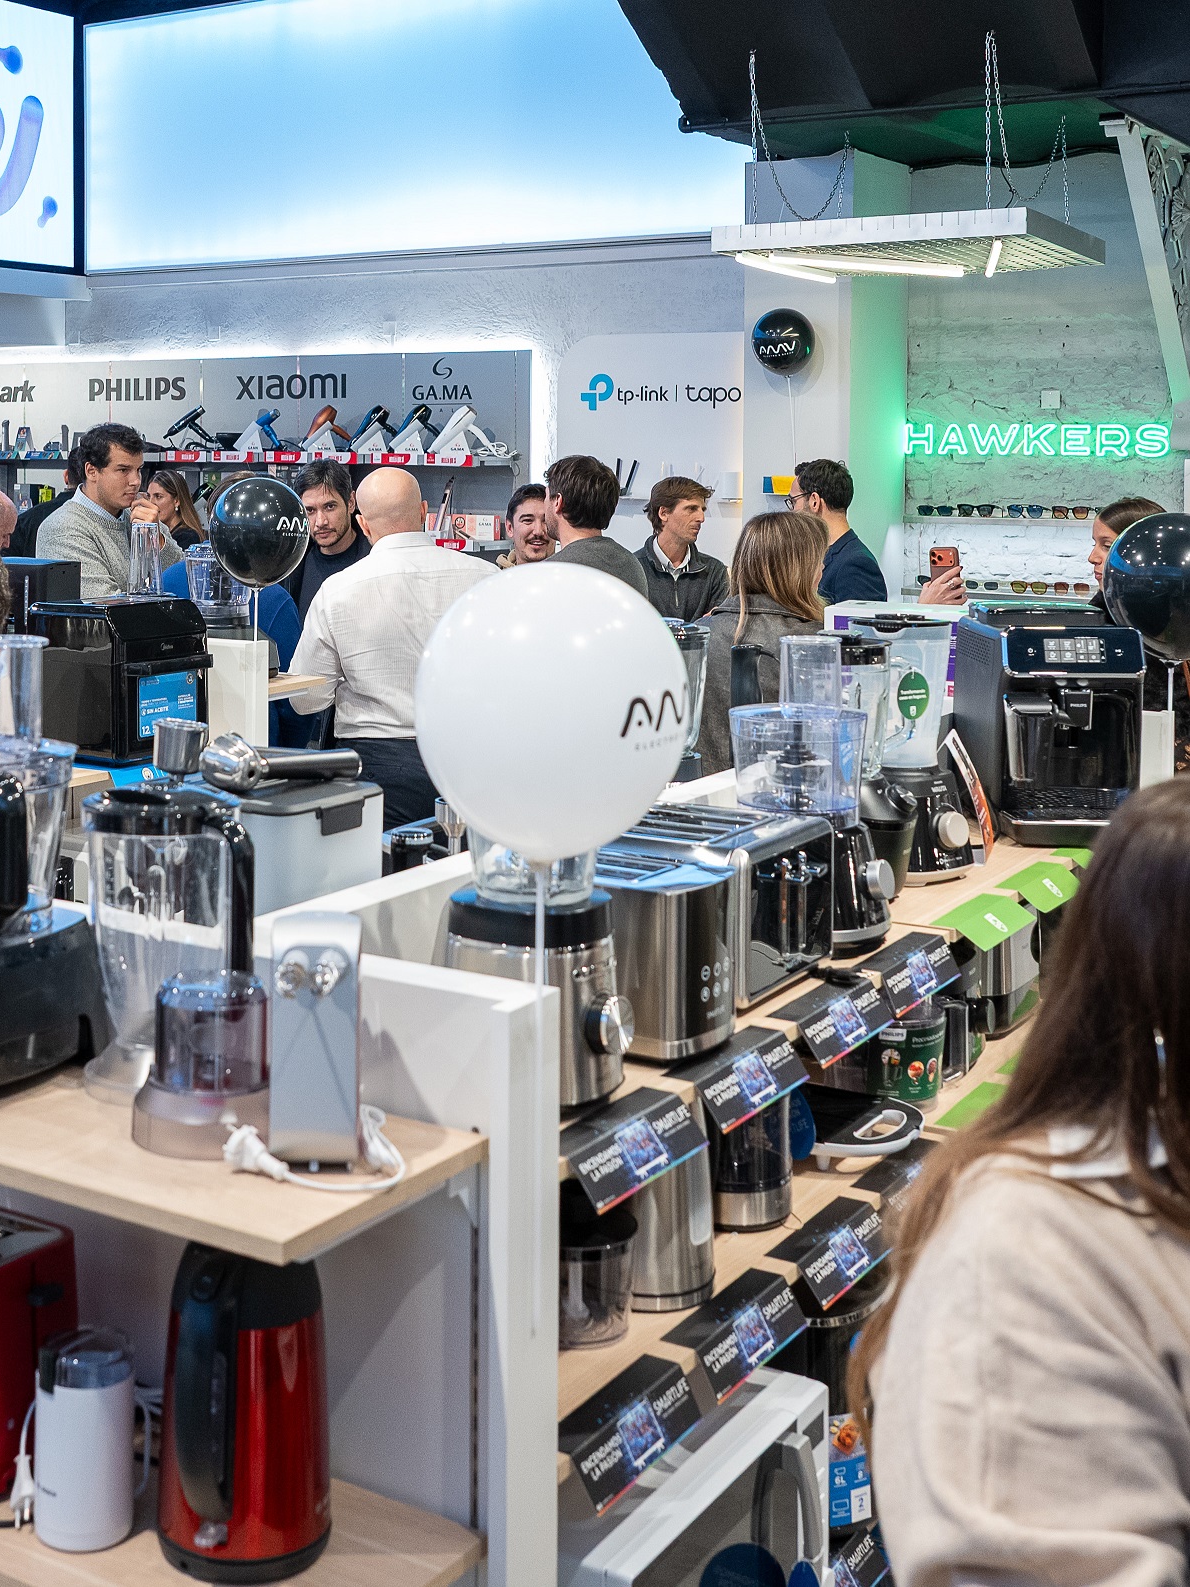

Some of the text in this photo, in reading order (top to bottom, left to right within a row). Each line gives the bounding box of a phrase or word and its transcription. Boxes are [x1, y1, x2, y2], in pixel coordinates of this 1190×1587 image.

[88, 376, 187, 402] PHILIPS
[236, 372, 347, 401] xiaomi
[412, 384, 473, 401] GA.MA
[617, 384, 742, 409] tp-link tapo
[903, 423, 1170, 458] HAWKERS
[853, 1211, 883, 1240] SMARTLIFE
[761, 1286, 795, 1320] SMARTLIFE
[652, 1376, 690, 1417] SMARTLIFE
[834, 1475, 846, 1486] 6L
[858, 1497, 865, 1509] 2
[846, 1533, 875, 1571] SMARTLIFE
